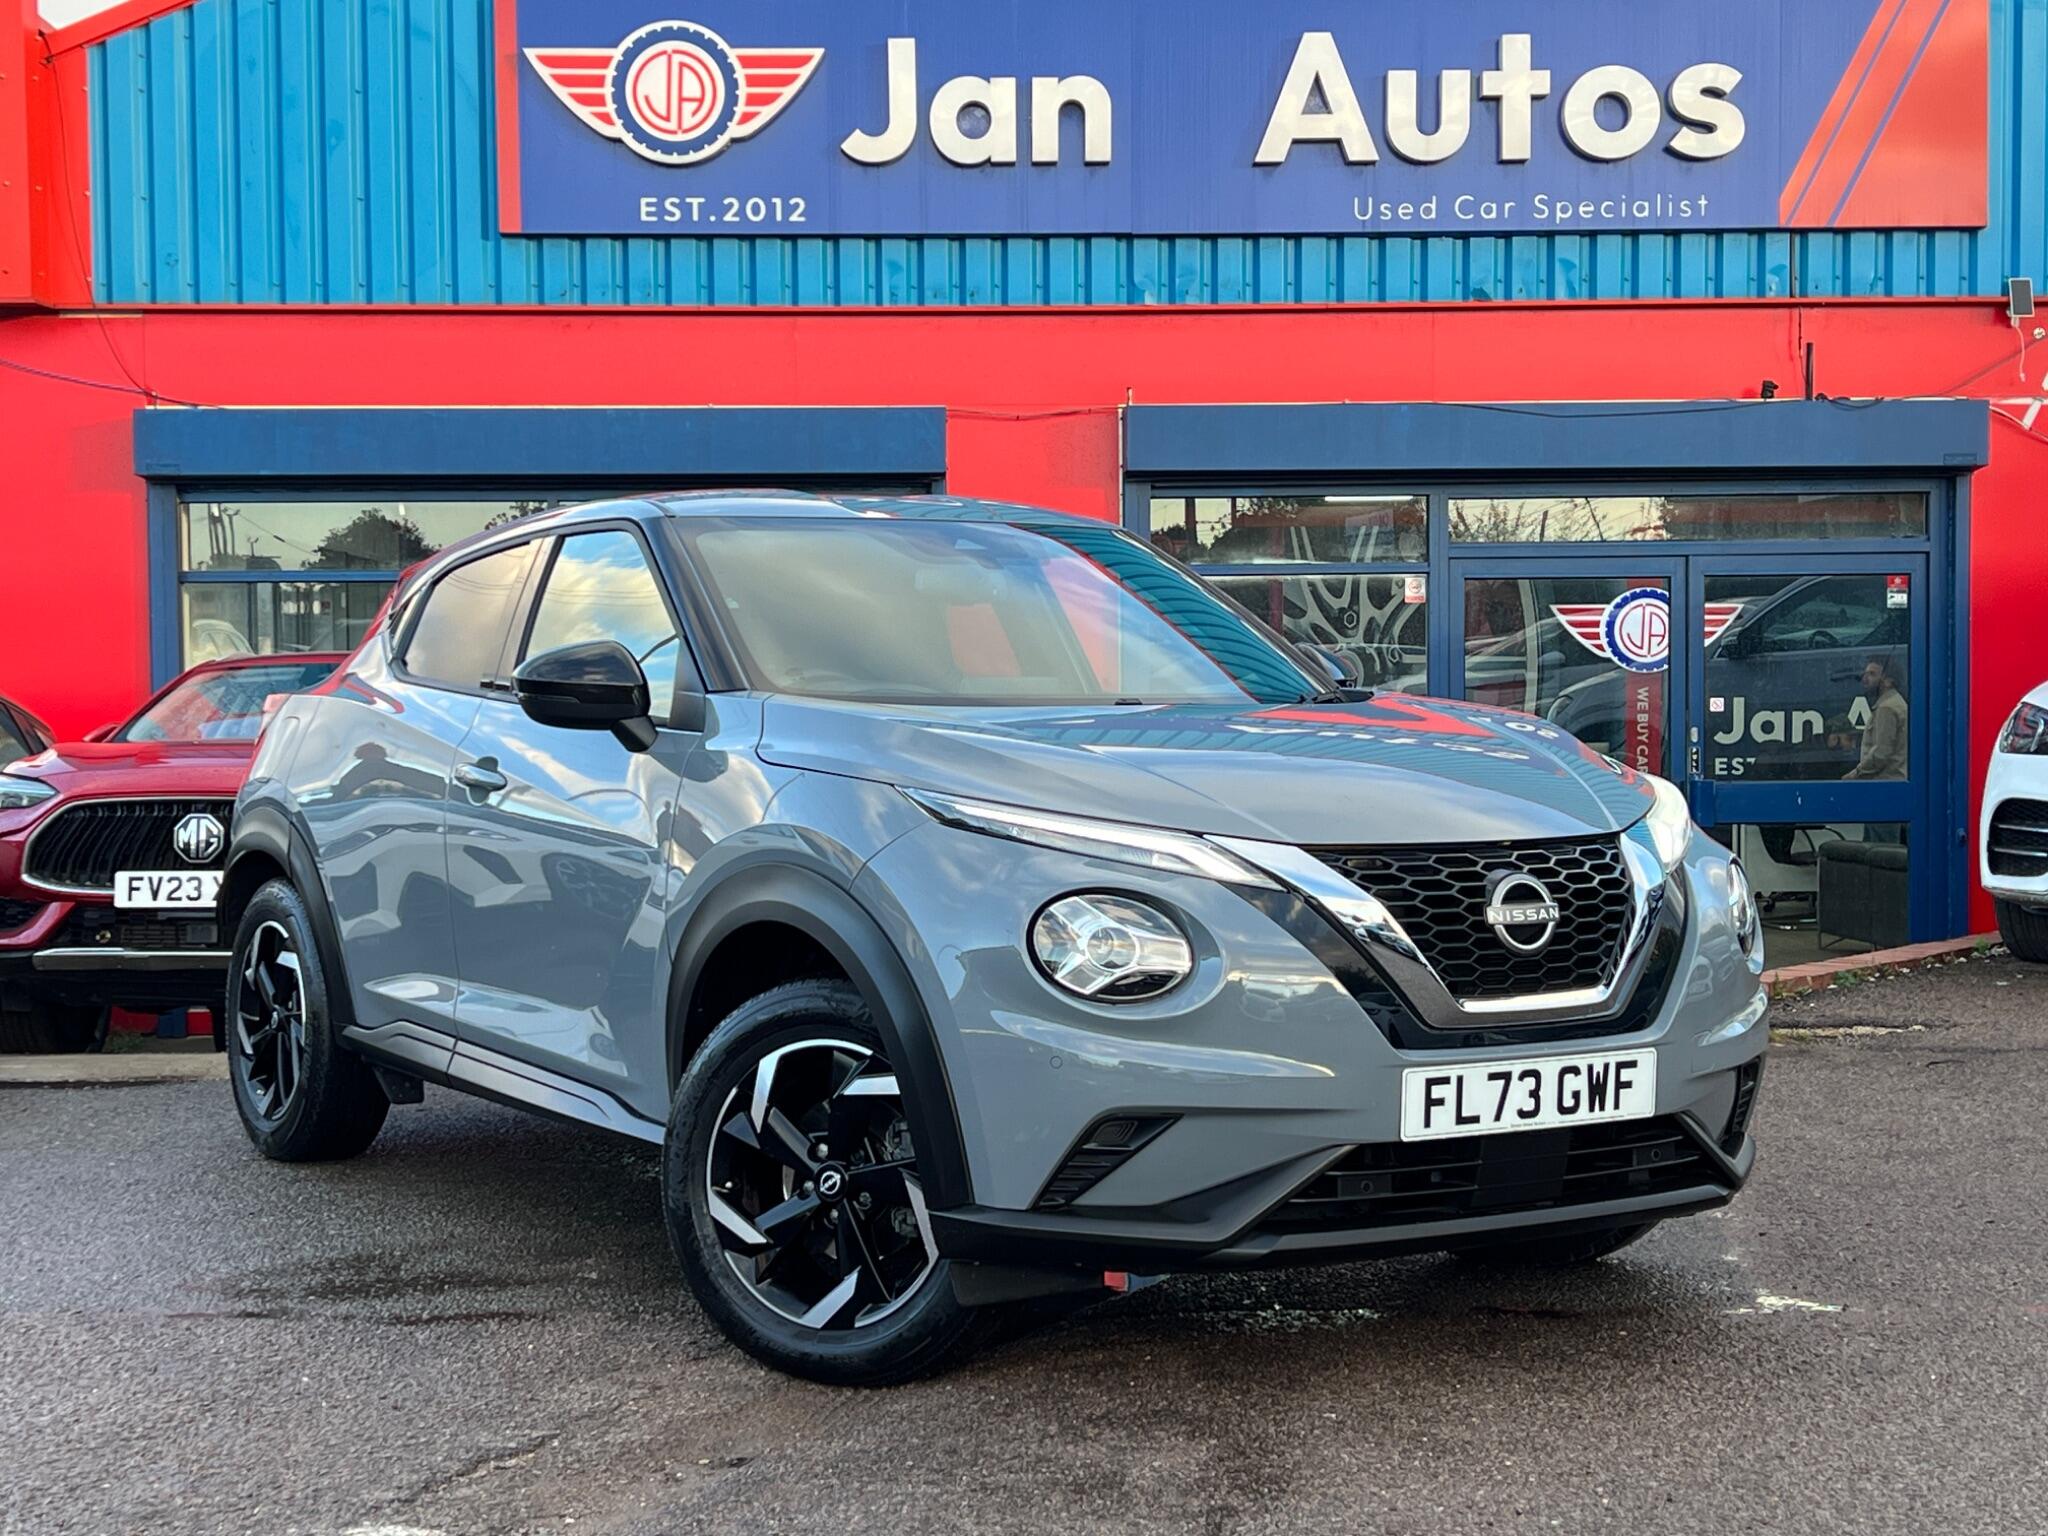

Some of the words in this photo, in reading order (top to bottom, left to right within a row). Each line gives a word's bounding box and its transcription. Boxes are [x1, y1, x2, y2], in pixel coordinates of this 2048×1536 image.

[840, 37, 1112, 165] Jan
[1253, 31, 1746, 164] Autos
[639, 196, 808, 223] EST.2012
[1353, 196, 1438, 221] Used
[1453, 194, 1517, 220] Car
[1532, 193, 1709, 224] Specialist
[1636, 687, 1649, 711] WE
[1636, 712, 1649, 743] BUY
[1713, 696, 1825, 745] Jan
[178, 817, 219, 859] MG
[127, 875, 203, 902] FV23
[1488, 906, 1560, 923] NISSAN
[1423, 1068, 1542, 1129] FL73
[1556, 1059, 1639, 1116] GWF
